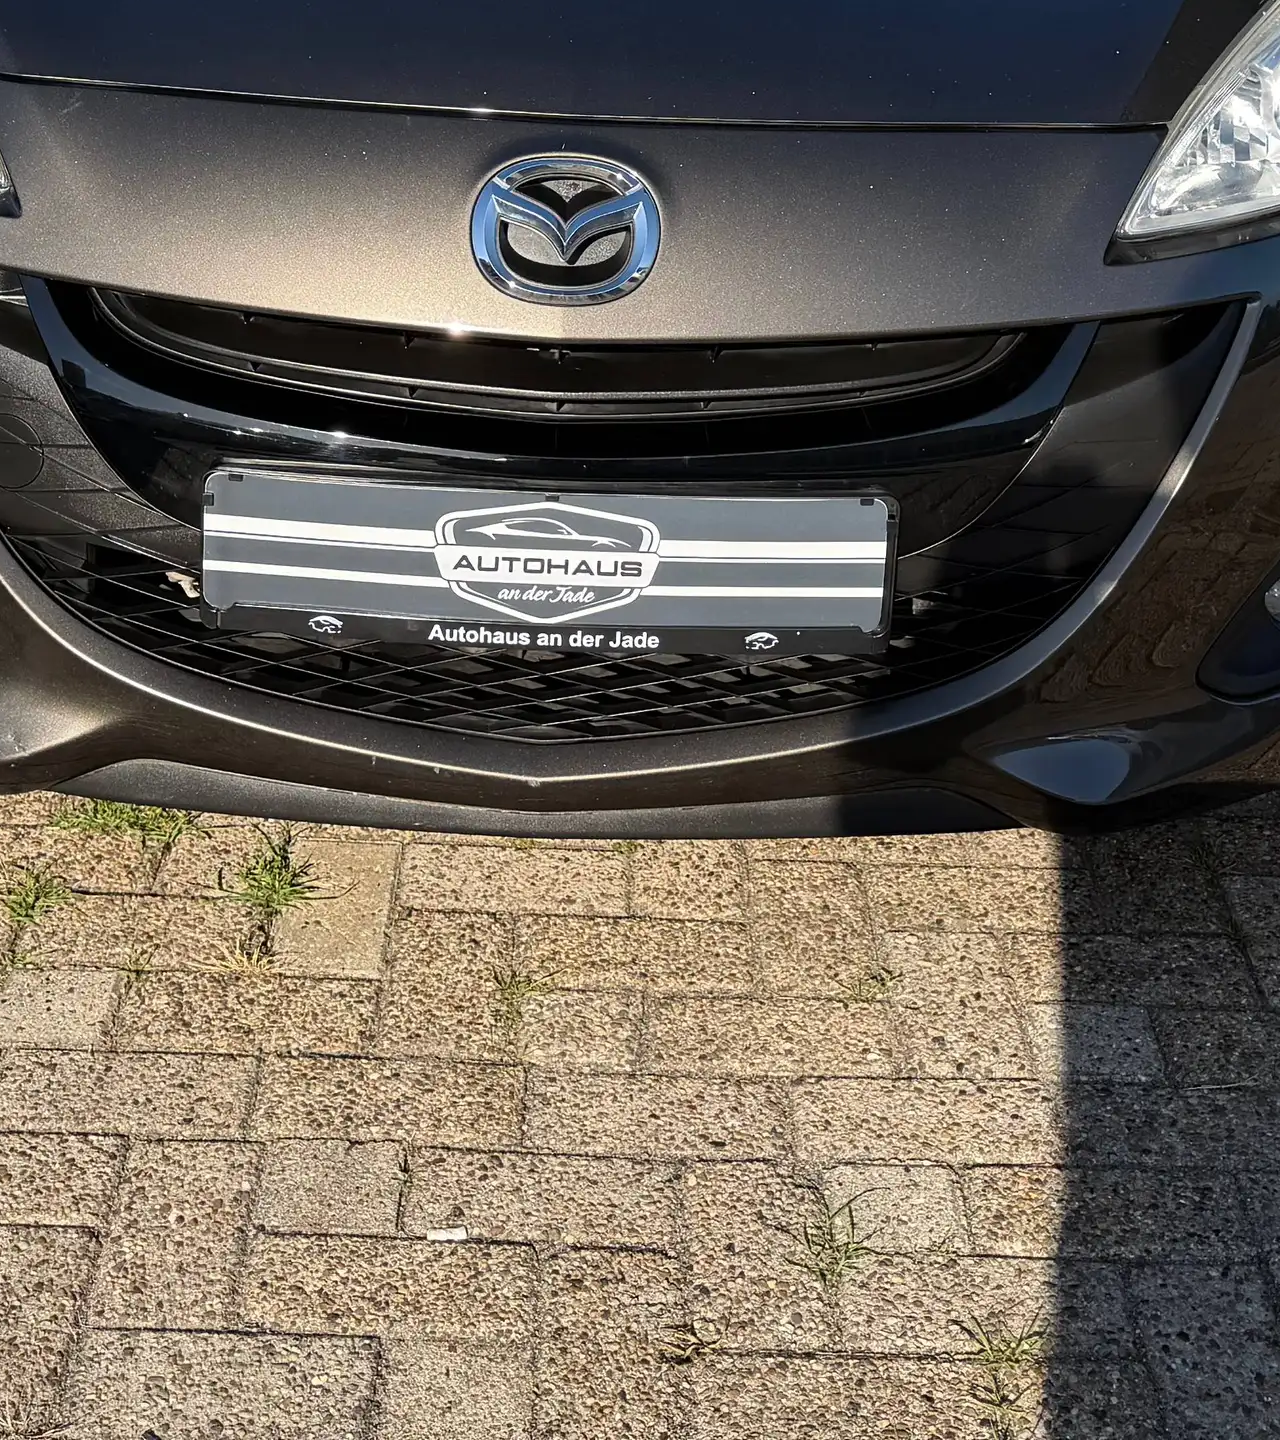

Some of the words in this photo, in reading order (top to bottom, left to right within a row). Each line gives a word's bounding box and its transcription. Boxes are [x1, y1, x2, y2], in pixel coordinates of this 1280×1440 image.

[452, 554, 643, 578] AUTOHAUS
[497, 587, 521, 601] an
[521, 585, 554, 601] der
[549, 586, 596, 604] Jade
[427, 623, 531, 646] Autohaus
[536, 633, 563, 647] an
[568, 630, 605, 648] der
[608, 631, 660, 649] Jade
